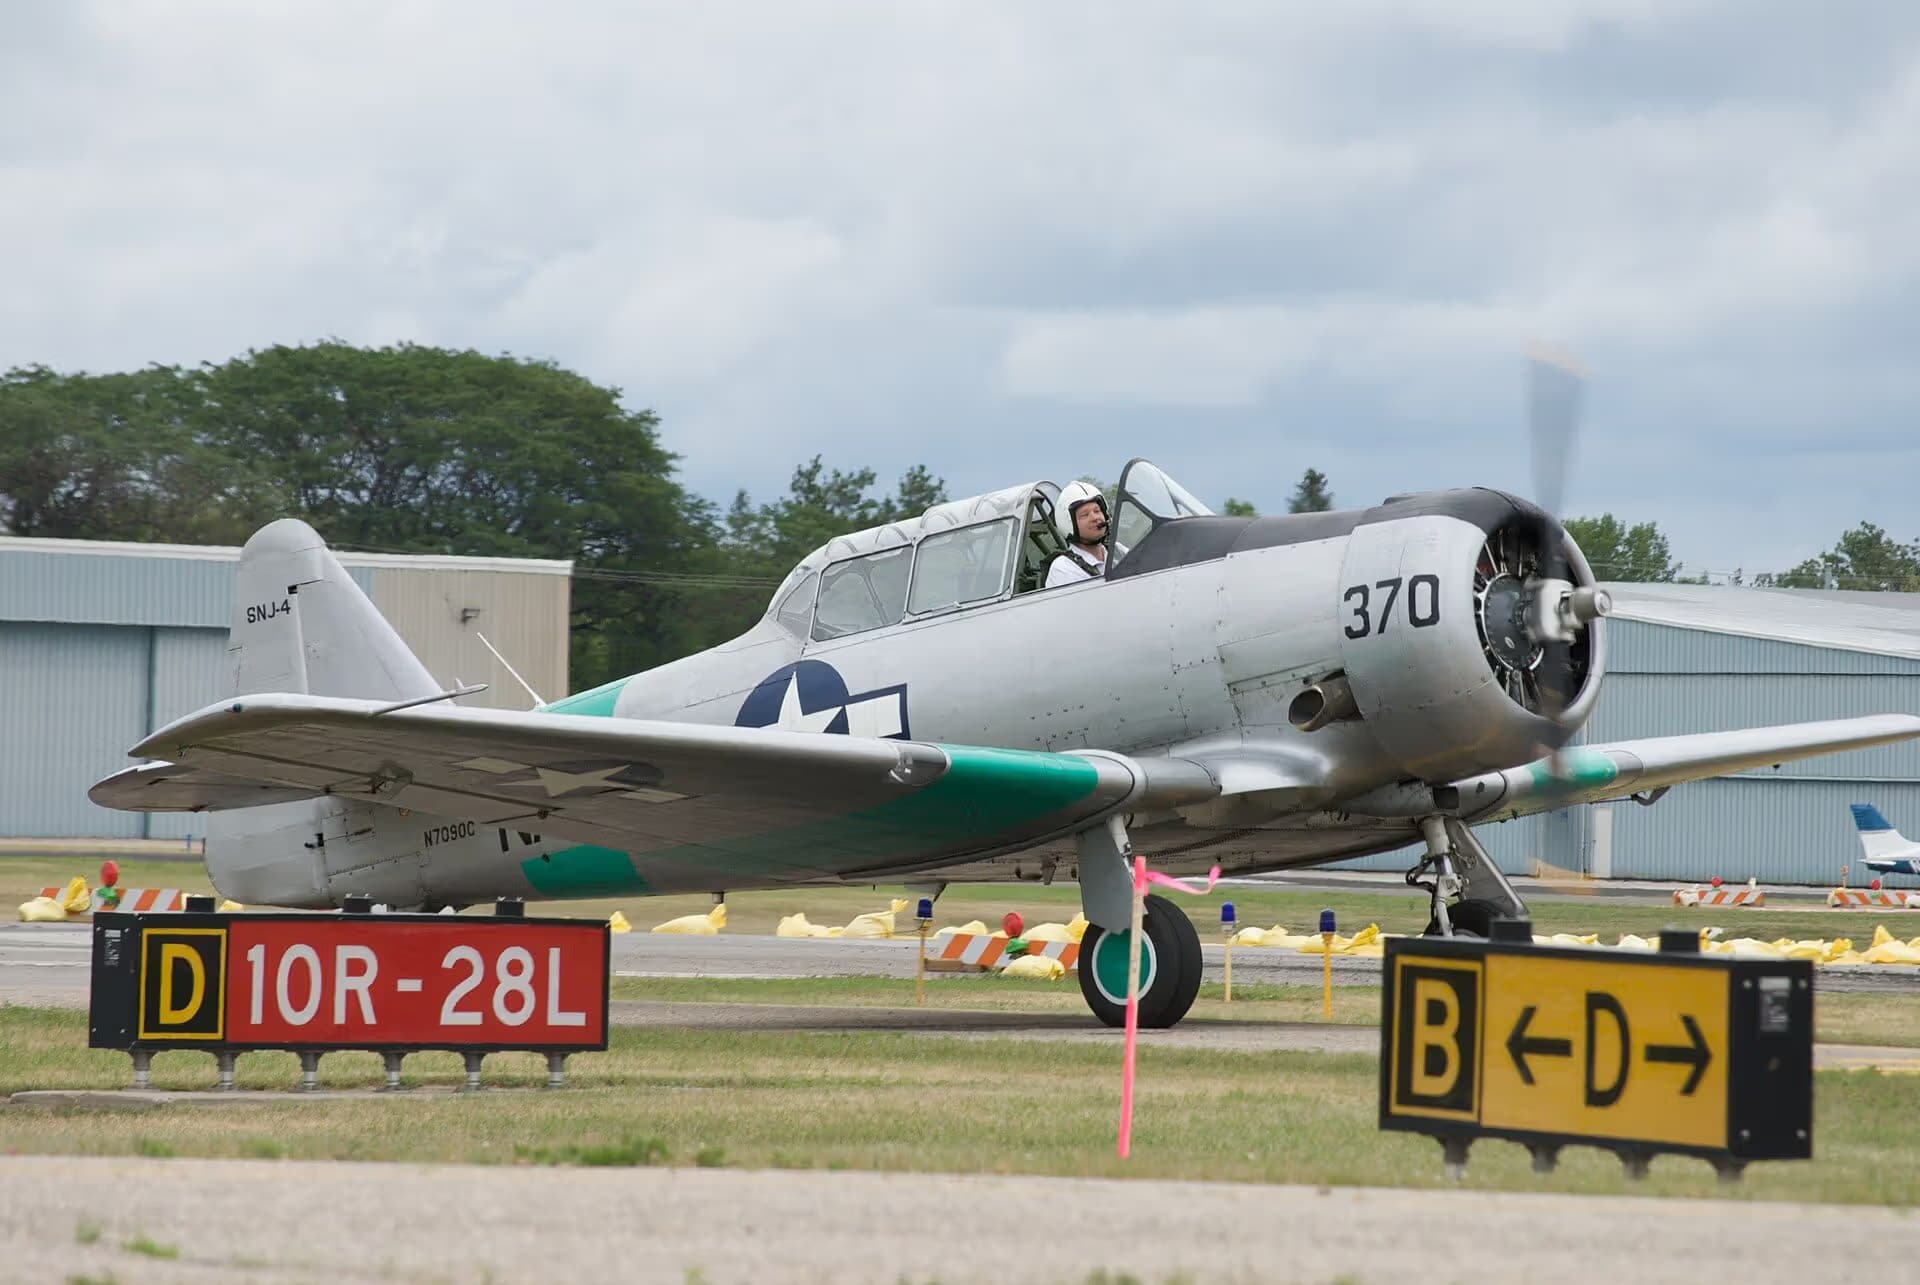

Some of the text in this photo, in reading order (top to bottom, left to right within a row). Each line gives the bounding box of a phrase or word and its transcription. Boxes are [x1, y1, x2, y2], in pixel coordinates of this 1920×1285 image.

[246, 599, 291, 624] SNJ-4
[1343, 574, 1440, 640] 370
[424, 821, 475, 848] N7090C
[158, 943, 205, 1025] D
[1411, 977, 1460, 1097] B
[1585, 991, 1631, 1107] D
